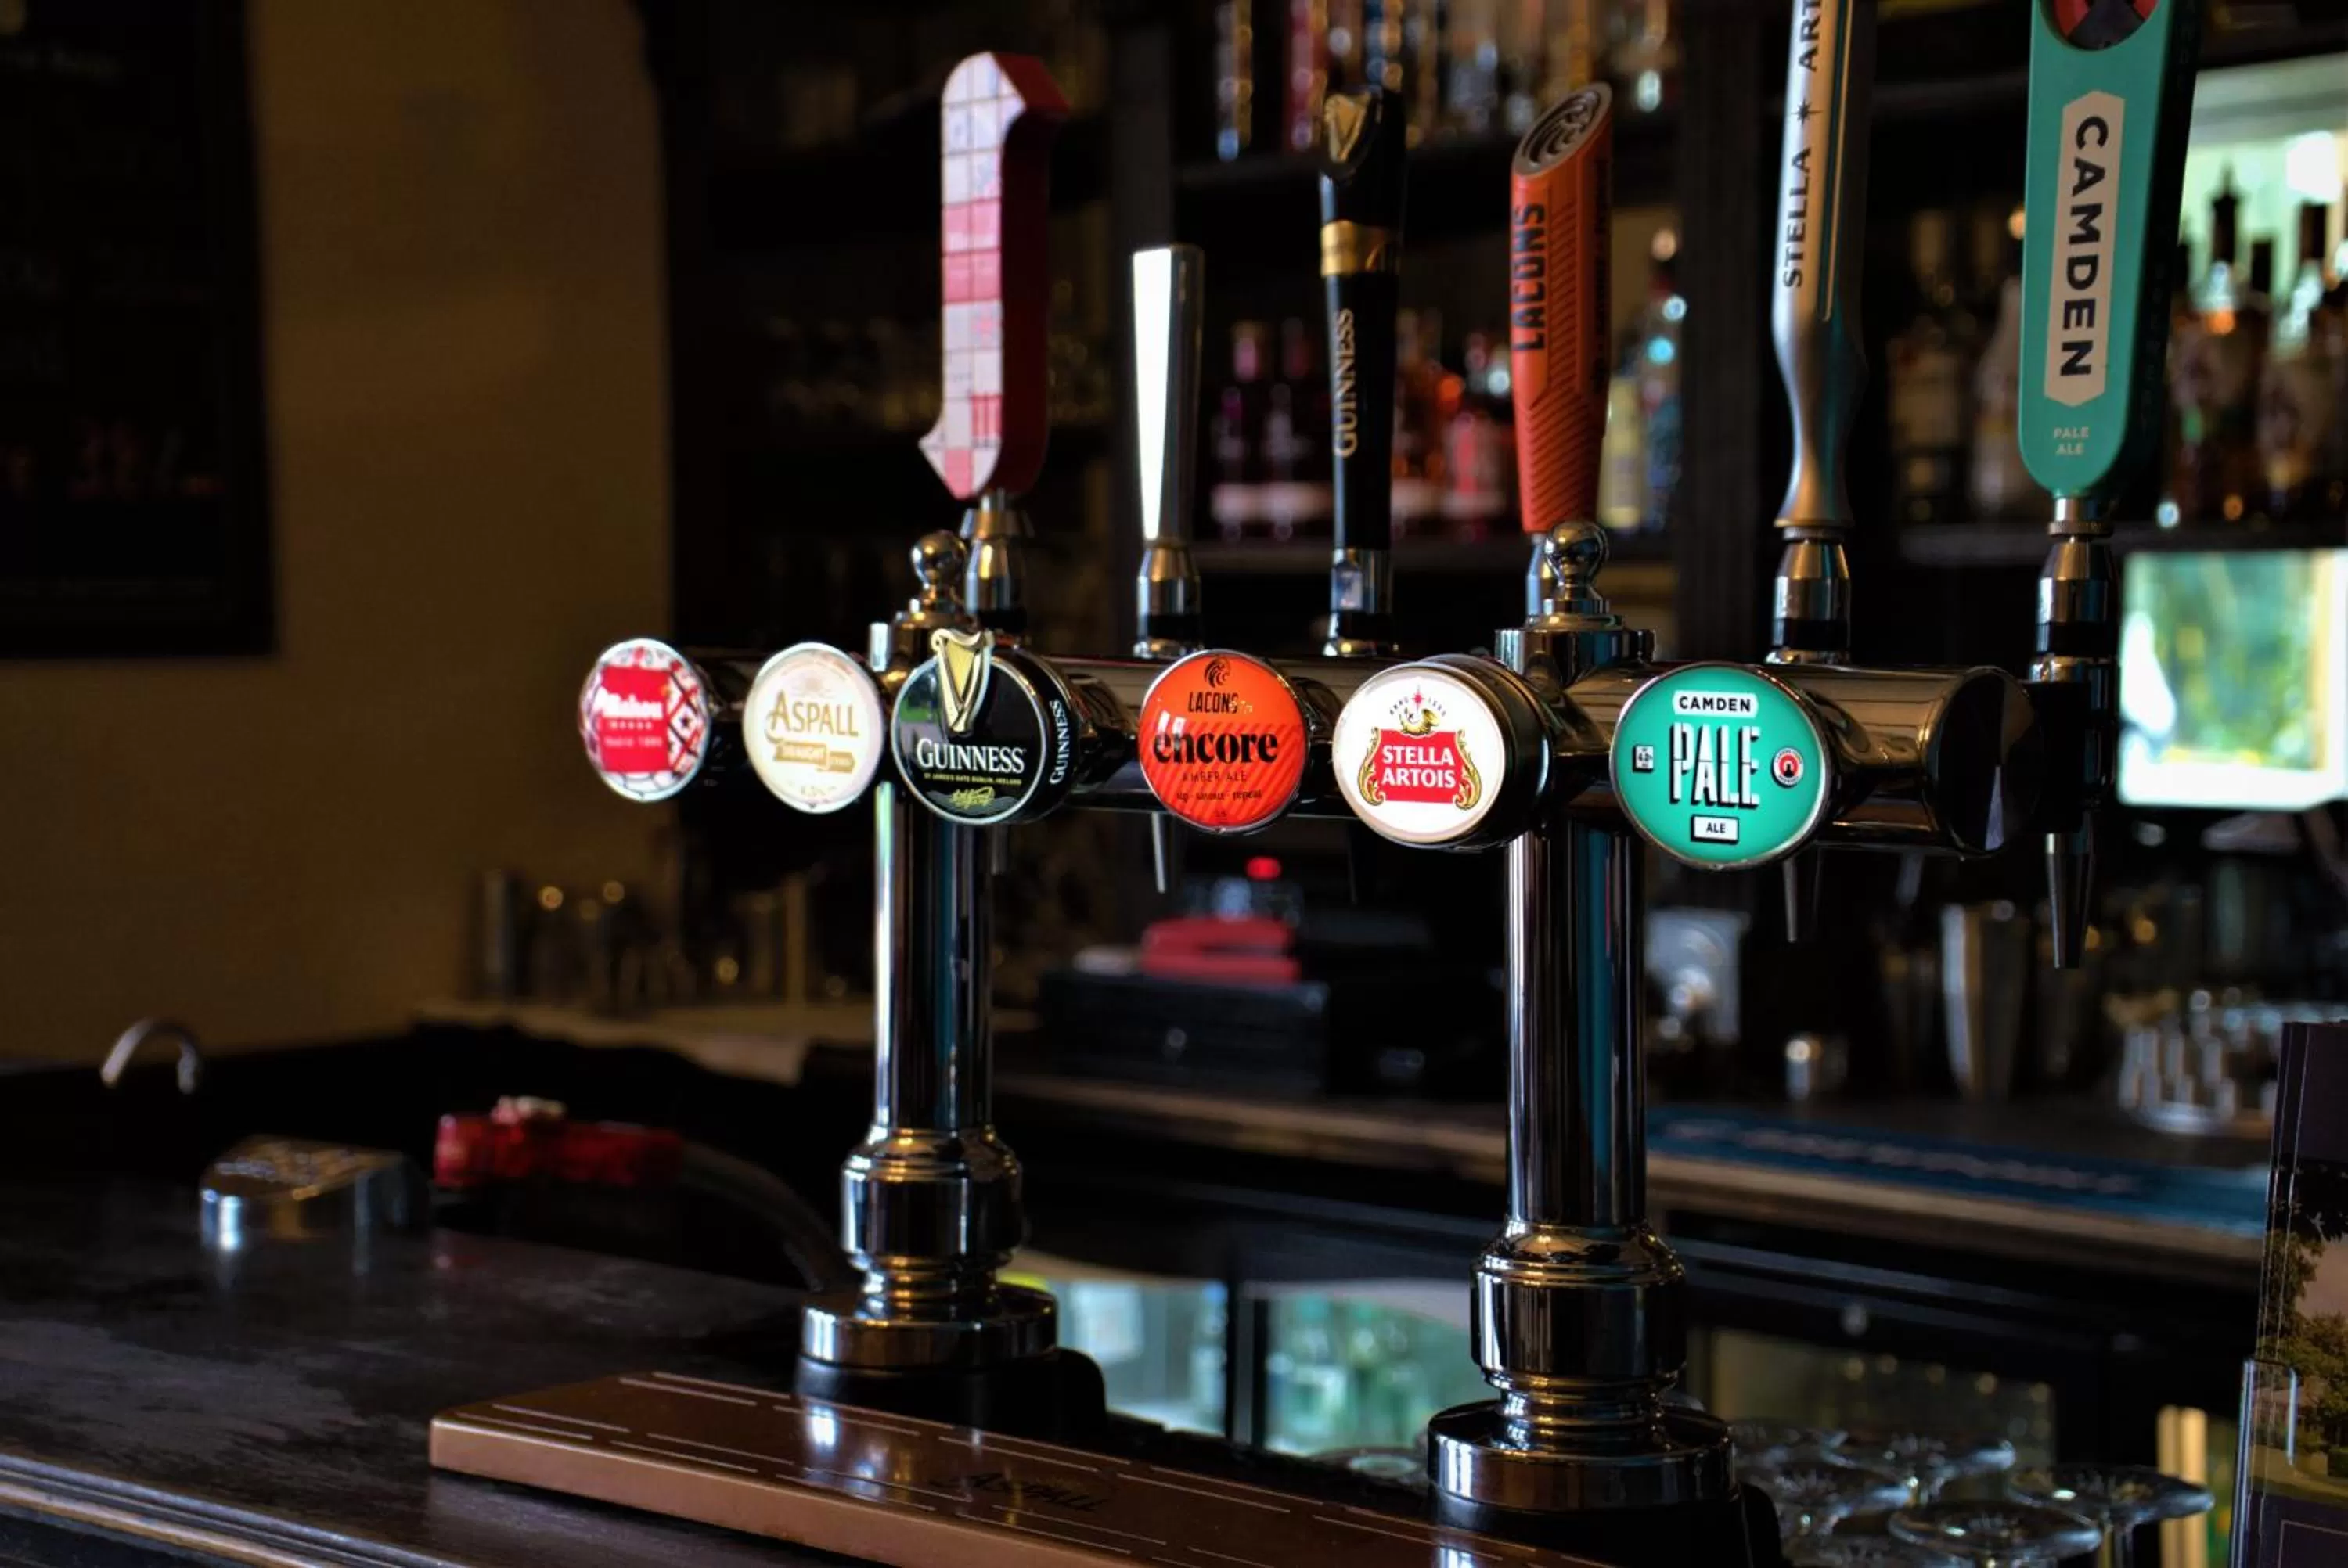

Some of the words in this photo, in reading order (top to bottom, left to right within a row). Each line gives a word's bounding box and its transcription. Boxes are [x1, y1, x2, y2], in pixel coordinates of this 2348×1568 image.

[1783, 147, 1810, 289] STELLA
[2060, 115, 2109, 377] CAMDEN
[1511, 203, 1547, 352] LACONS
[1334, 307, 1358, 459] GUINNESS
[2053, 426, 2089, 439] PALE
[2056, 443, 2084, 455] ALE
[1188, 692, 1239, 714] LACONS
[1679, 696, 1751, 712] CAMDEN
[917, 738, 1025, 774] GUINNESS
[1050, 700, 1070, 785] GUINNESS
[1154, 732, 1278, 764] encore
[1382, 745, 1456, 766] STELLA
[1183, 770, 1219, 782] AMBER
[1226, 770, 1247, 782] ALE
[1381, 768, 1457, 789] ARTOIS
[1669, 722, 1760, 808] PALE
[1706, 822, 1726, 834] ALE
